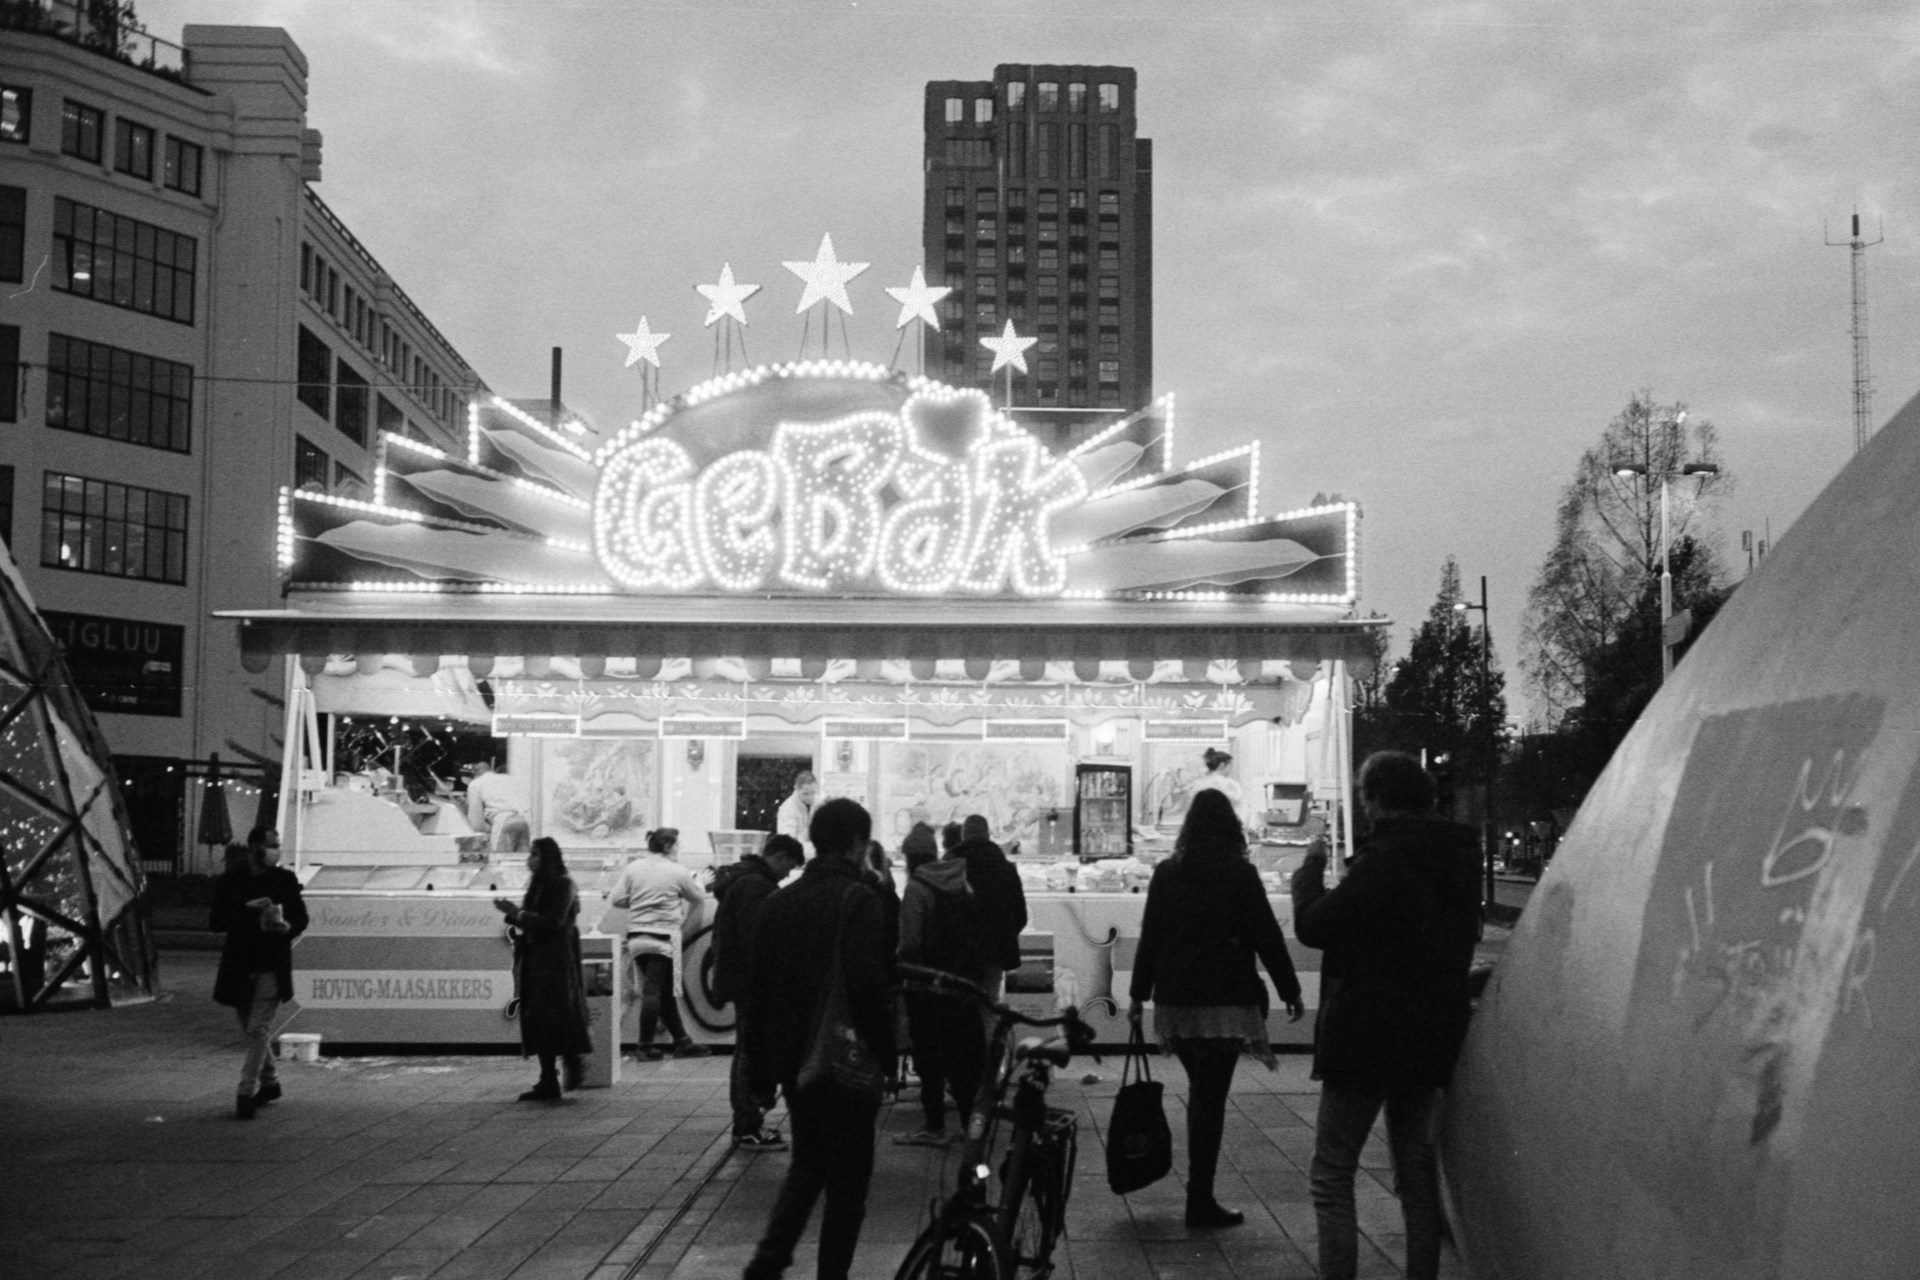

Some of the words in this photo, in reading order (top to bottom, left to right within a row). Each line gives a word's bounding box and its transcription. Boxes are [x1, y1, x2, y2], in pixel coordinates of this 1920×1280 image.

[69, 620, 160, 653] IGLUU
[398, 906, 417, 928] &
[312, 978, 493, 1000] HOVING-MAASAKKERS
